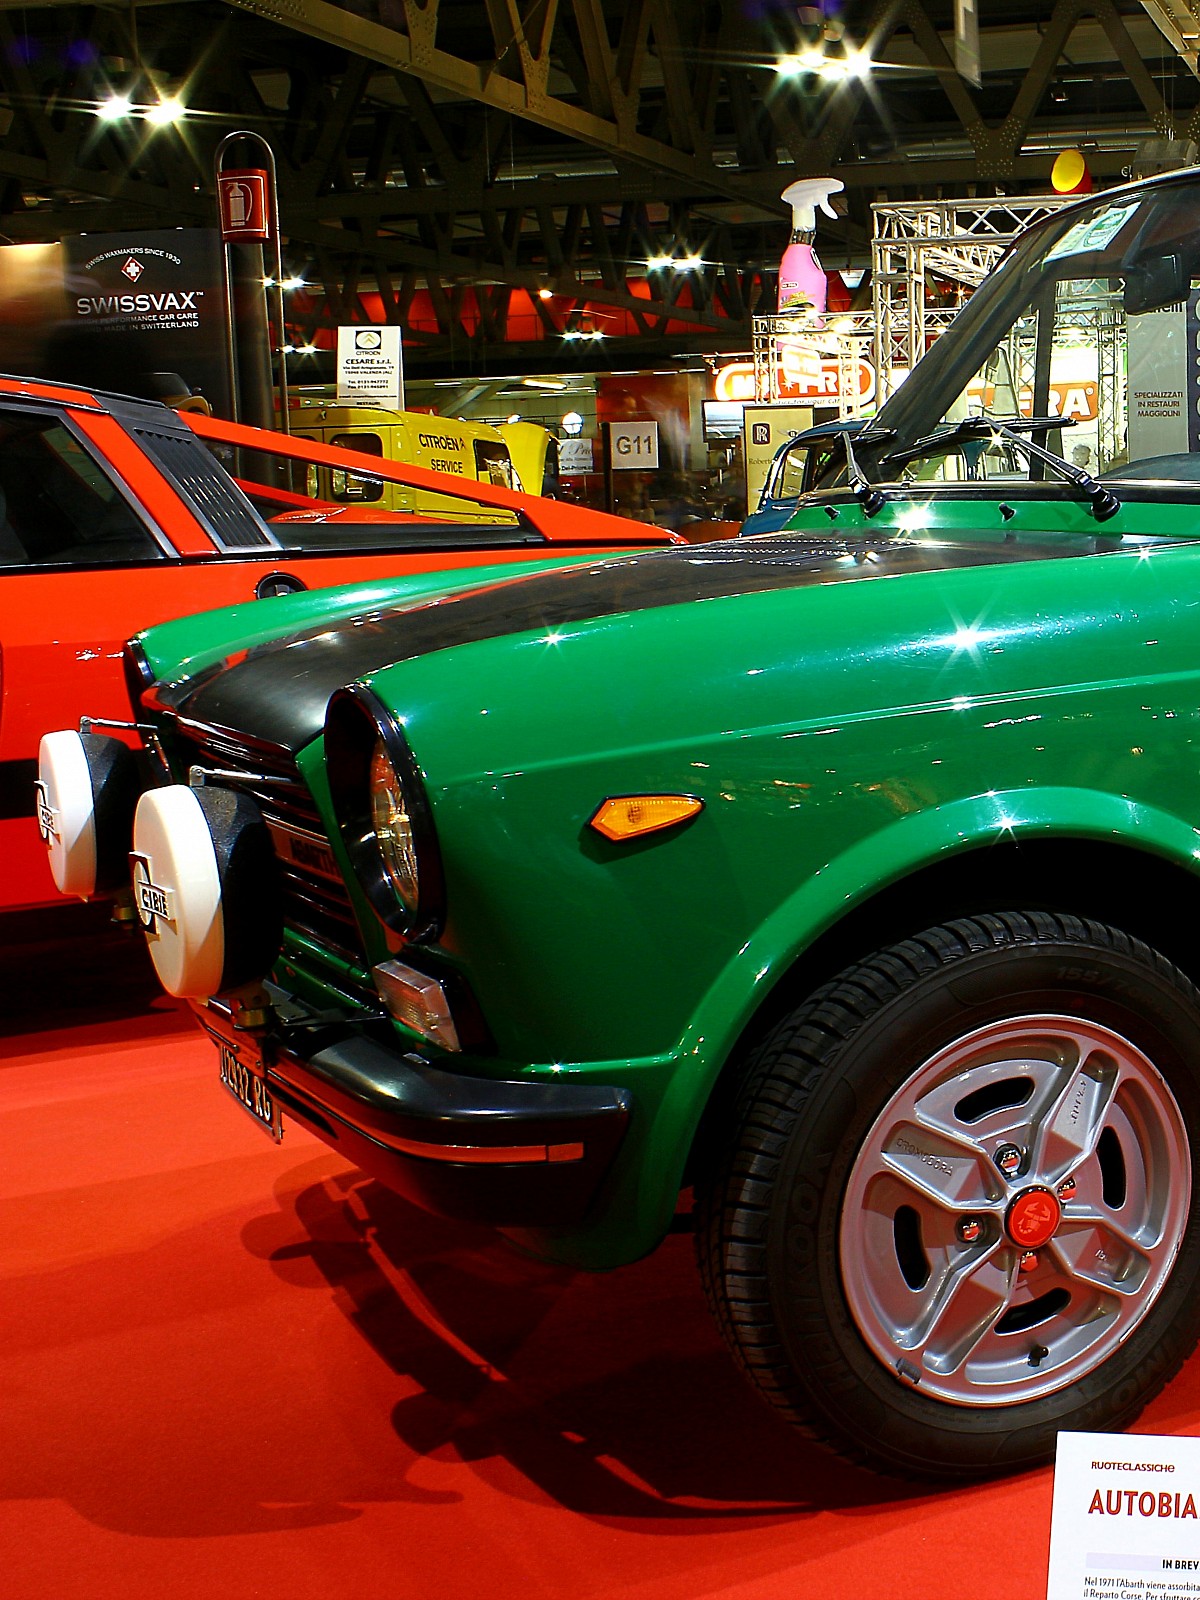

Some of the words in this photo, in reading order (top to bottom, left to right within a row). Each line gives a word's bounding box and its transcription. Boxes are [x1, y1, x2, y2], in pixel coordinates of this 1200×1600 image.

[85, 254, 105, 270] SWISS
[104, 247, 144, 259] WAXMAKERS
[144, 247, 165, 257] SINCE
[165, 252, 181, 265] 1930
[159, 313, 175, 321] CAR
[176, 312, 199, 320] CARE
[129, 323, 139, 331] IN
[141, 320, 199, 330] SWITZERLAND
[1134, 391, 1183, 399] SPECIALIZZATI
[418, 433, 460, 452] CITROËN
[616, 435, 654, 455] G11
[430, 458, 464, 474] SERVICE
[1162, 1559, 1173, 1569] IN
[1084, 1576, 1098, 1586] Nel
[1100, 1578, 1115, 1587] 1971
[1116, 1578, 1145, 1589] l'Abarth
[1147, 1581, 1166, 1590] viene
[1168, 1581, 1200, 1592] assorbita
[1083, 1588, 1089, 1598] il
[1090, 1589, 1119, 1600] Reparto
[1146, 1591, 1158, 1600] Per
